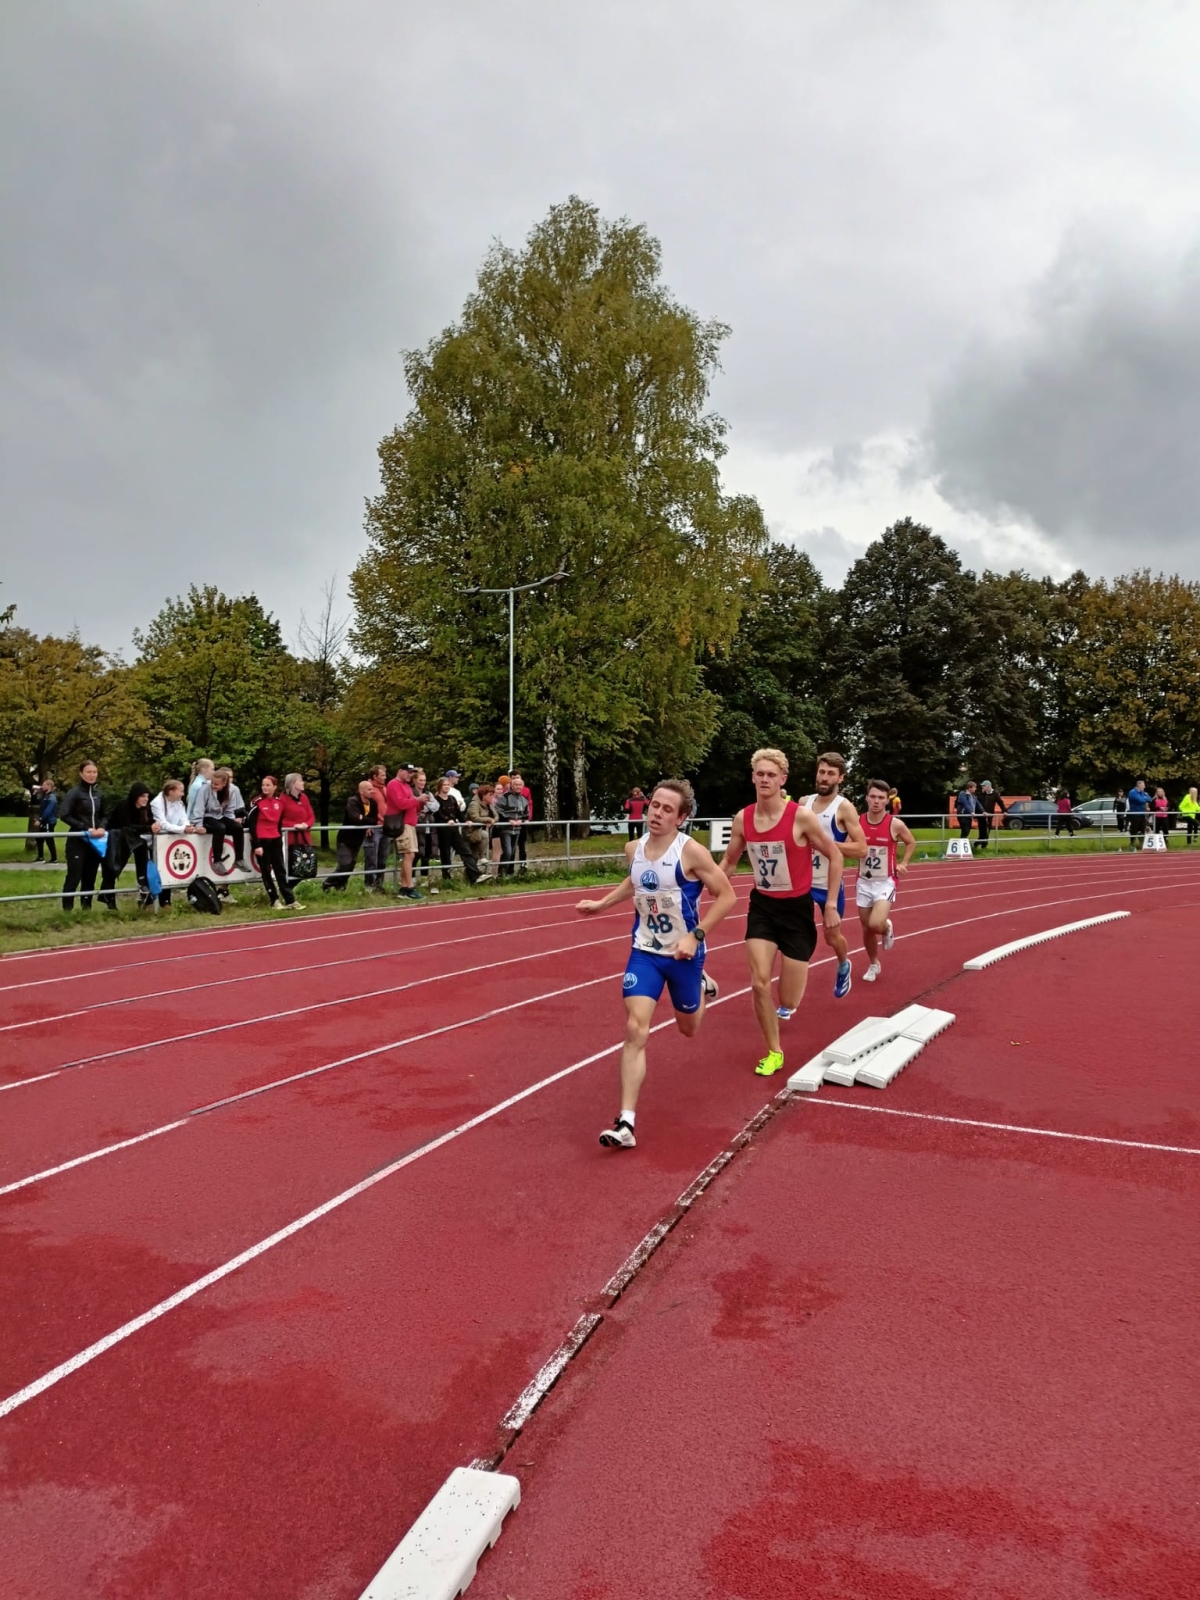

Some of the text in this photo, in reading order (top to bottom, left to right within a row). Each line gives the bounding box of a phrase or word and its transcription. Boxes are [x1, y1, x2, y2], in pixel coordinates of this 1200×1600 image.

[951, 842, 958, 853] 6
[963, 842, 969, 853] 6
[1147, 837, 1154, 848] 5
[1158, 838, 1164, 847] 5
[758, 859, 778, 877] 37
[865, 857, 881, 870] 42
[647, 913, 673, 934] 48
